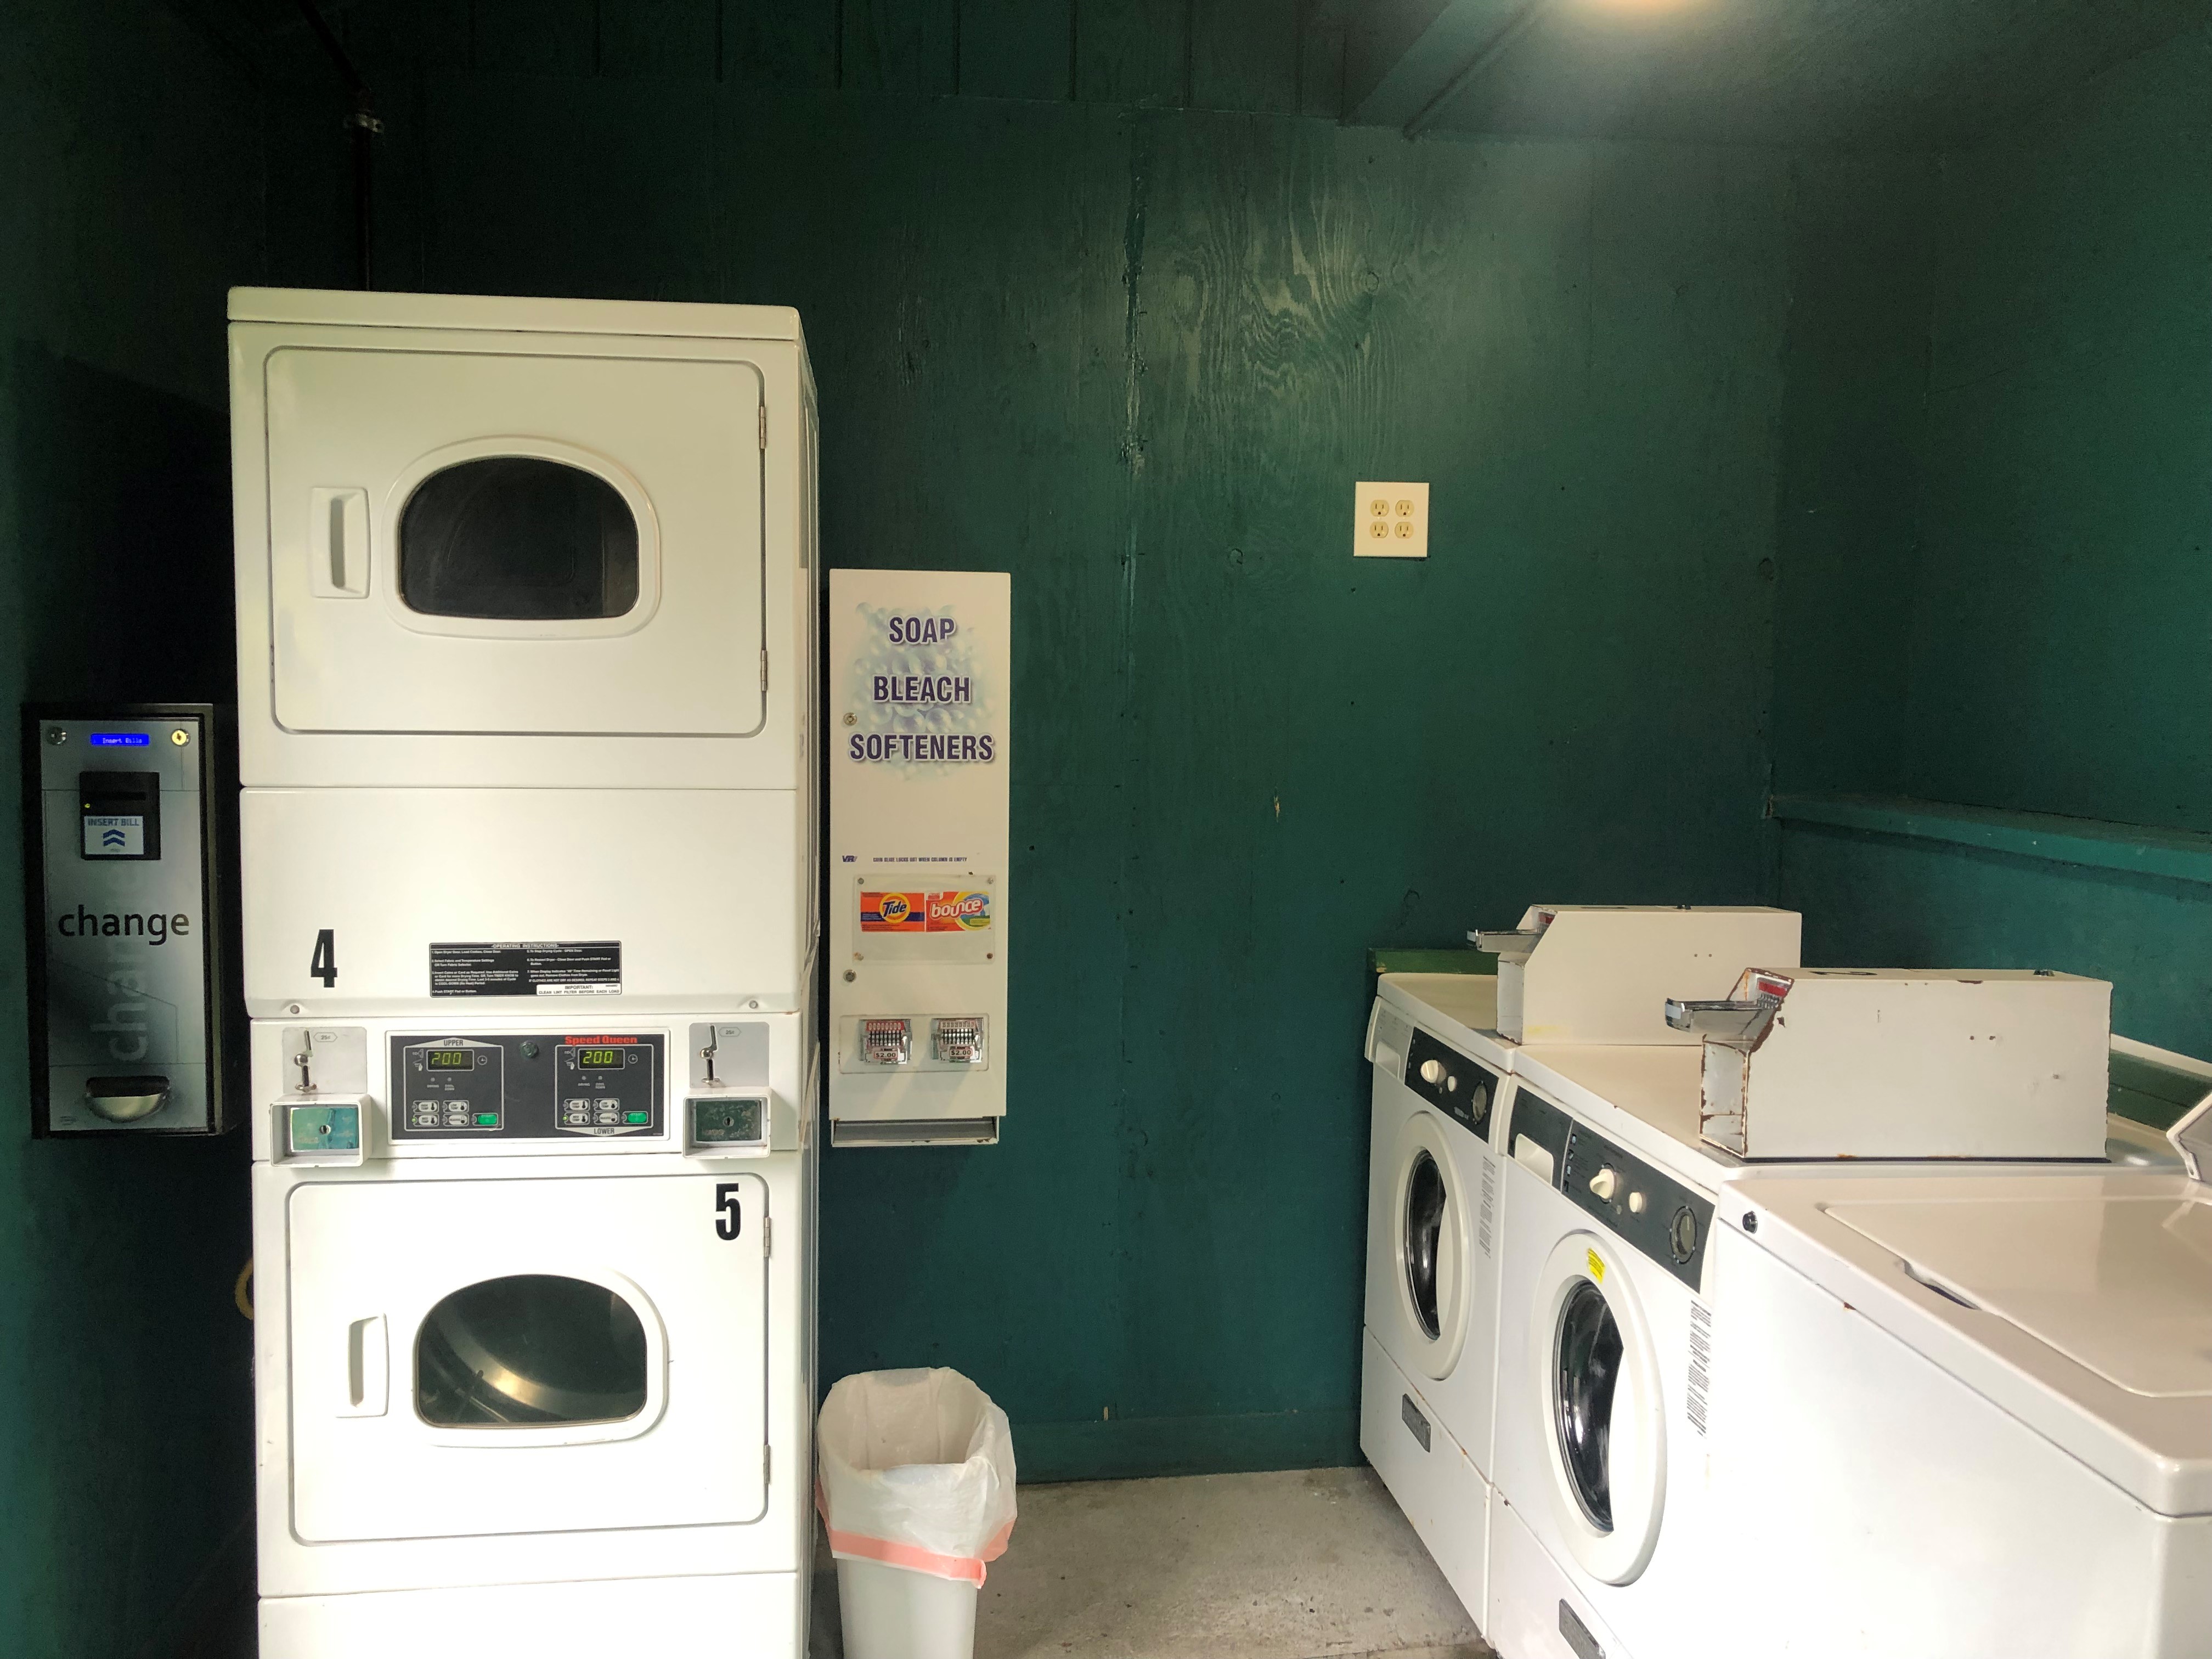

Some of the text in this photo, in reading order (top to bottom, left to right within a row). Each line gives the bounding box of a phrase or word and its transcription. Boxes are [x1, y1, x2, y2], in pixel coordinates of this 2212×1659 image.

[889, 617, 955, 643] SOAP
[873, 676, 970, 702] BLEACH
[850, 734, 992, 760] SOFTENERS
[87, 818, 119, 826] INSERT
[883, 900, 907, 918] Tide
[931, 899, 982, 918] bounce
[58, 905, 190, 946] change
[311, 929, 337, 988] 4
[565, 1035, 637, 1047] Speed Queen
[583, 1051, 613, 1064] 200
[715, 1183, 741, 1241] 5
